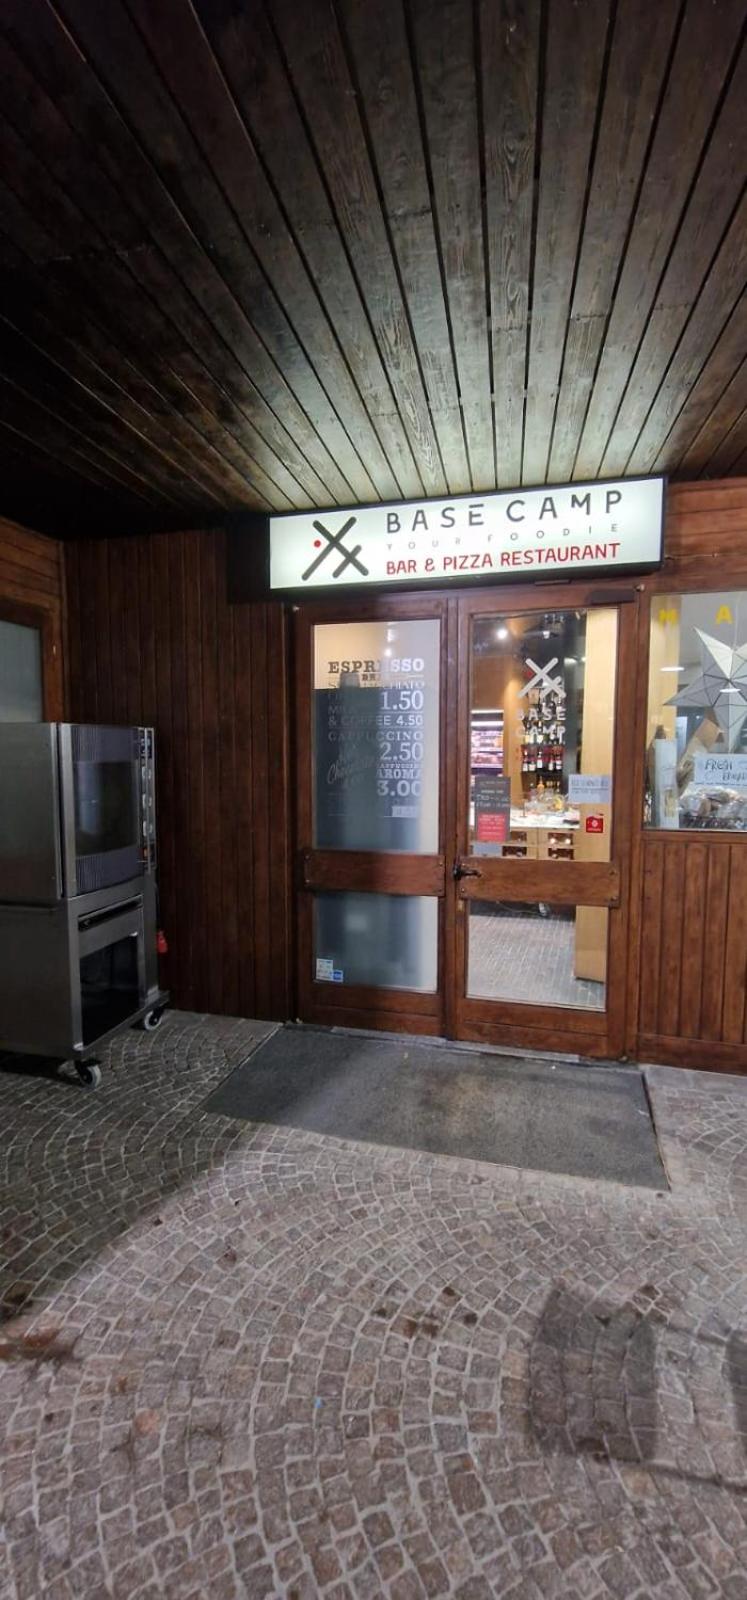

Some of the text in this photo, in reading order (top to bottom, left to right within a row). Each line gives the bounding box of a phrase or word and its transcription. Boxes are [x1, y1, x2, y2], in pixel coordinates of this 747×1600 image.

[386, 490, 623, 533] BASE CAMP
[386, 523, 619, 551] YOUR FOODIE
[386, 543, 621, 575] BAR & PIZZA RESTAURANT
[328, 658, 425, 674] ESPRSSO
[381, 690, 424, 711] 1.50
[396, 714, 424, 727] 4.50
[515, 706, 567, 721] BASE
[515, 724, 567, 738] CAMP
[380, 741, 424, 762] 2.50
[377, 779, 422, 798] 3.00
